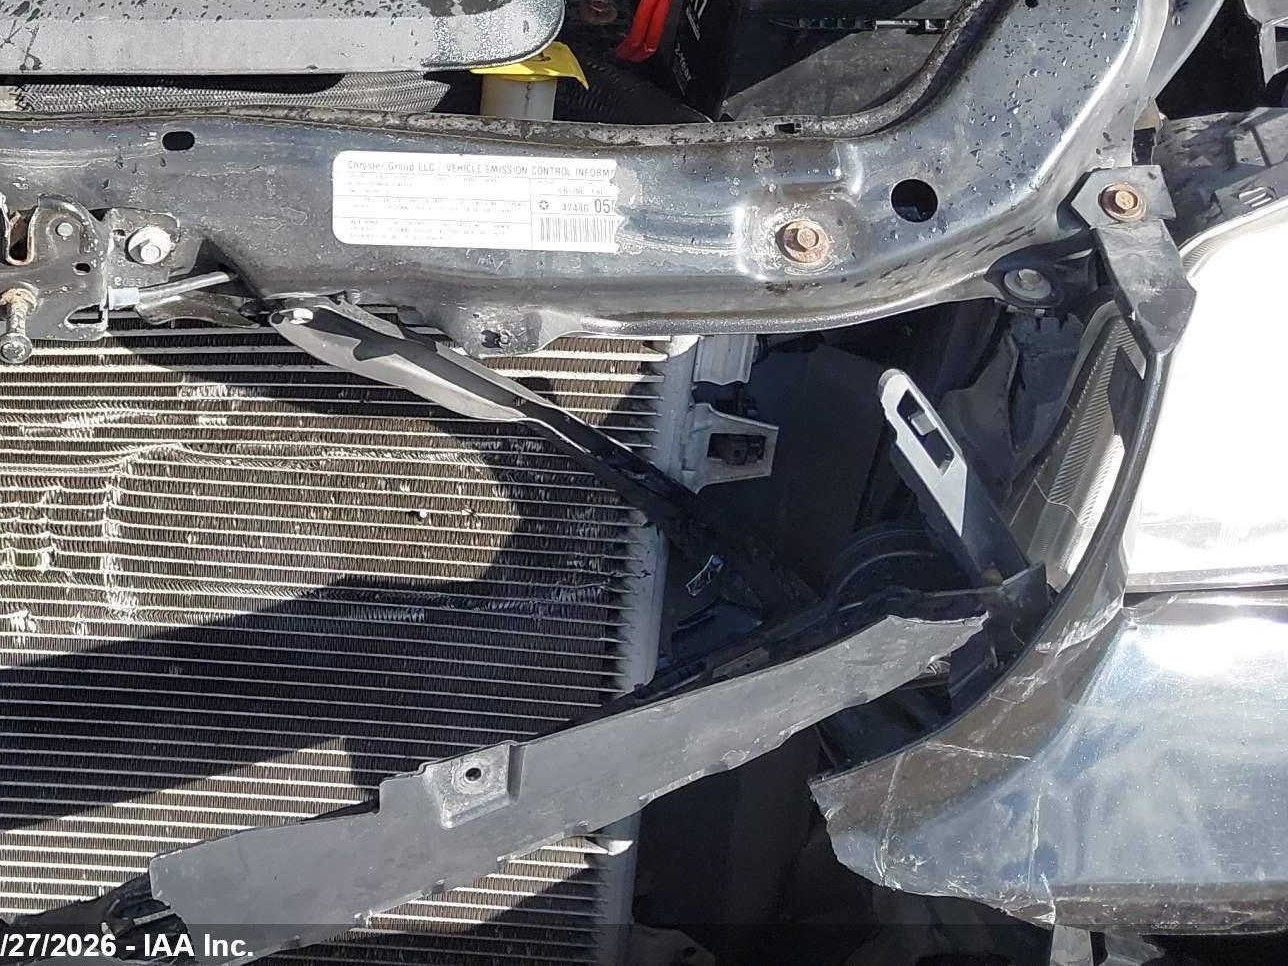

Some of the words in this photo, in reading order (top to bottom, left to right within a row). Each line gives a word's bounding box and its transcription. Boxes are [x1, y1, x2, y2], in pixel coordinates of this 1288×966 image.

[347, 160, 385, 171] Chrysler
[387, 161, 415, 172] Group
[418, 162, 435, 173] LLC
[446, 163, 481, 174] VEHICLE
[485, 164, 528, 175] EMISSION
[531, 166, 570, 177] CONTROL
